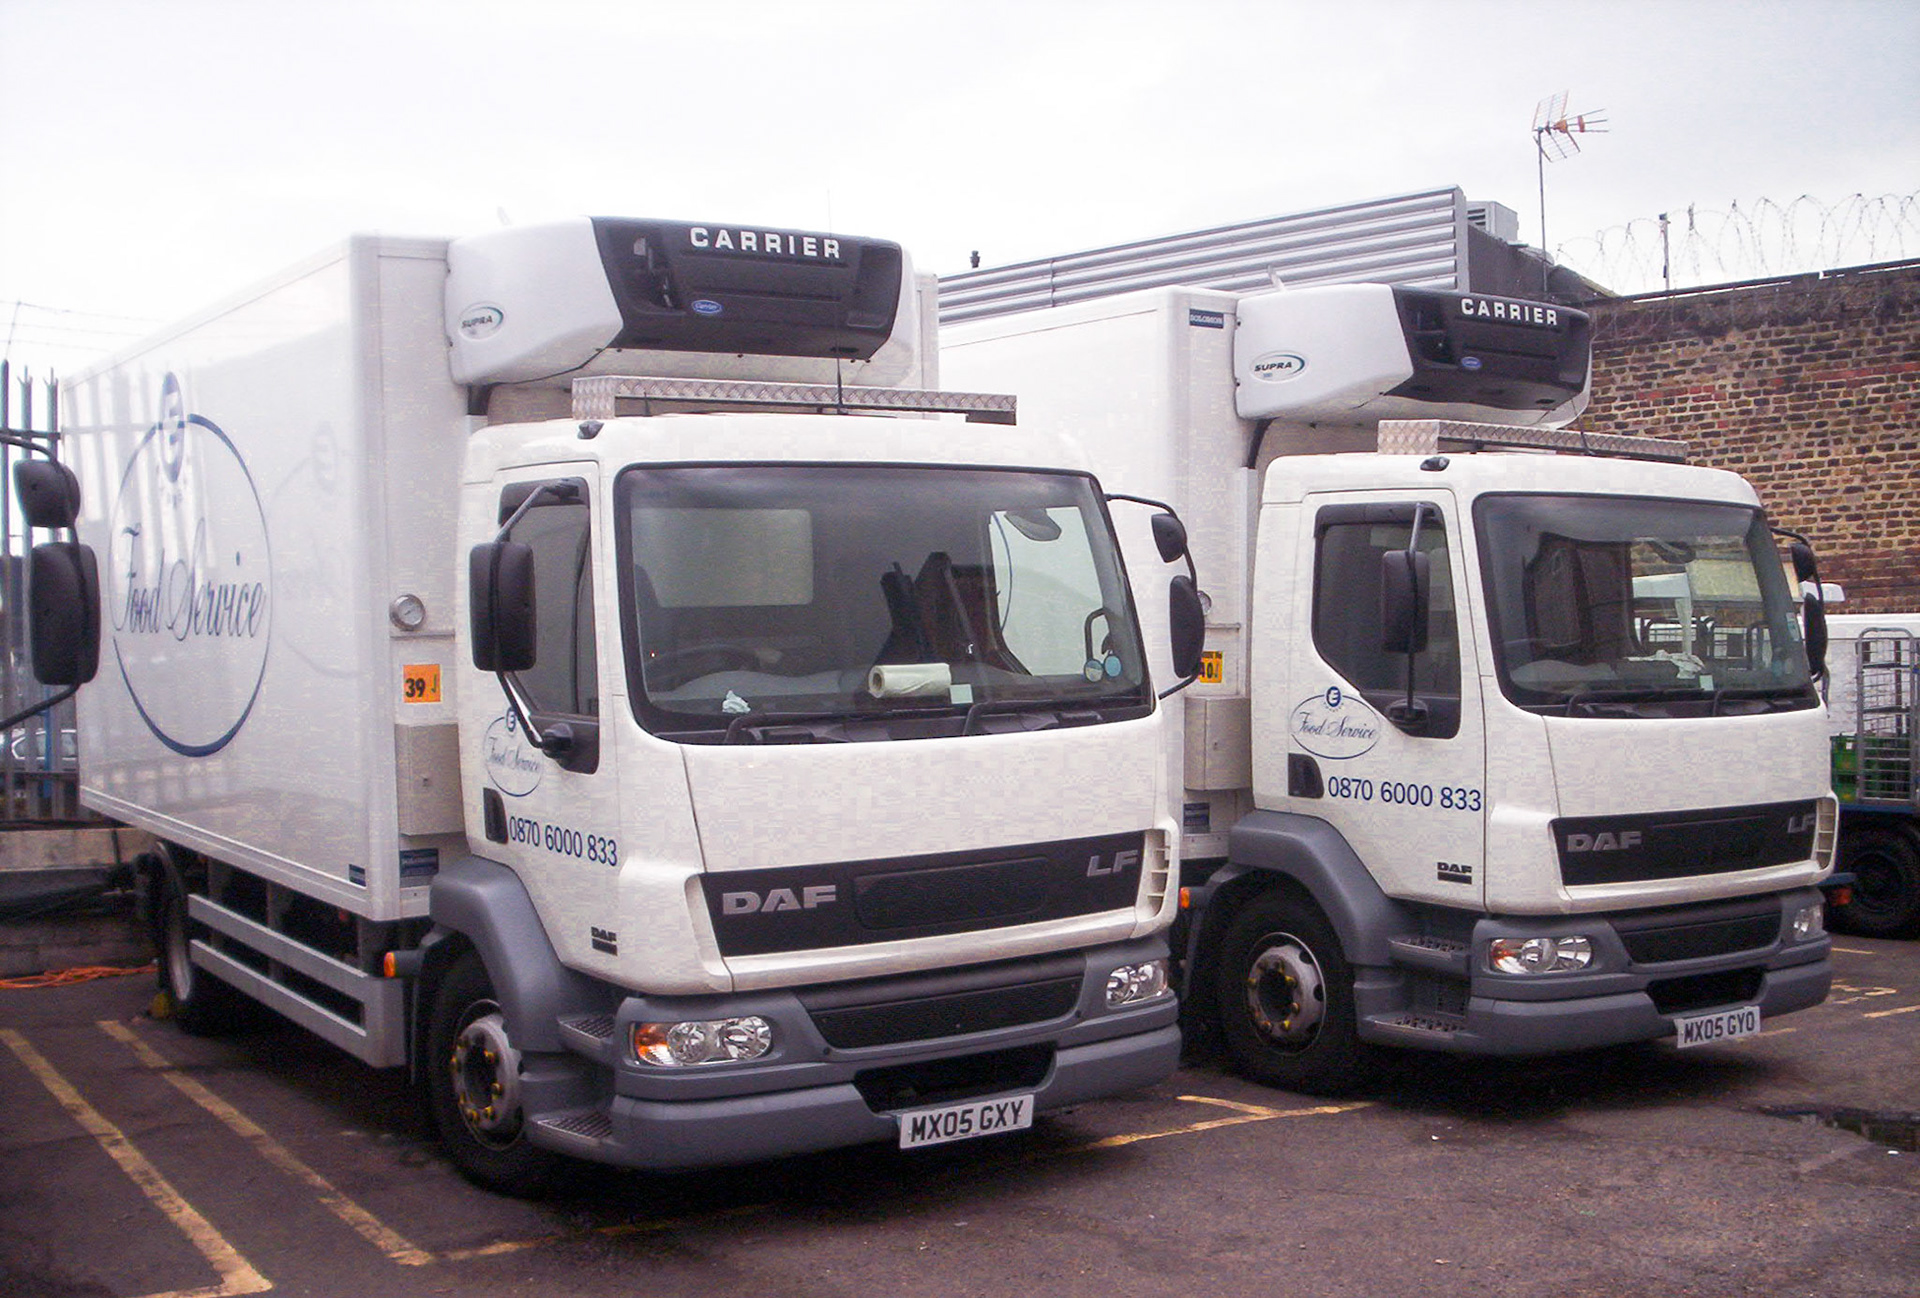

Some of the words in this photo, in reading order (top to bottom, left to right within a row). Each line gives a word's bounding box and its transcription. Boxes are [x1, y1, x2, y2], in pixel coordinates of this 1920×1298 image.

[690, 227, 840, 259] CARRIER
[462, 315, 493, 328] SUPRA
[1461, 298, 1558, 325] CARRIER
[1254, 361, 1293, 372] SUPRA
[112, 523, 165, 633] Food
[166, 517, 266, 641] Service
[405, 677, 426, 698] 39
[1298, 711, 1328, 735] Food
[1326, 715, 1377, 739] Service
[1328, 776, 1373, 801] 0870
[1381, 781, 1433, 807] 6000
[1440, 787, 1482, 811] 833
[1787, 813, 1817, 833] LF
[509, 816, 540, 847] 0870
[545, 825, 583, 858] 6000
[587, 834, 618, 866] 833
[1567, 831, 1642, 851] DAF
[1087, 849, 1139, 877] LF
[1437, 862, 1472, 874] DAF
[722, 885, 836, 915] DAF
[591, 926, 617, 942] DAF
[1683, 1017, 1724, 1044] MX05
[1727, 1011, 1755, 1035] GYO
[910, 1108, 974, 1142] MX05
[980, 1100, 1024, 1130] GXY
